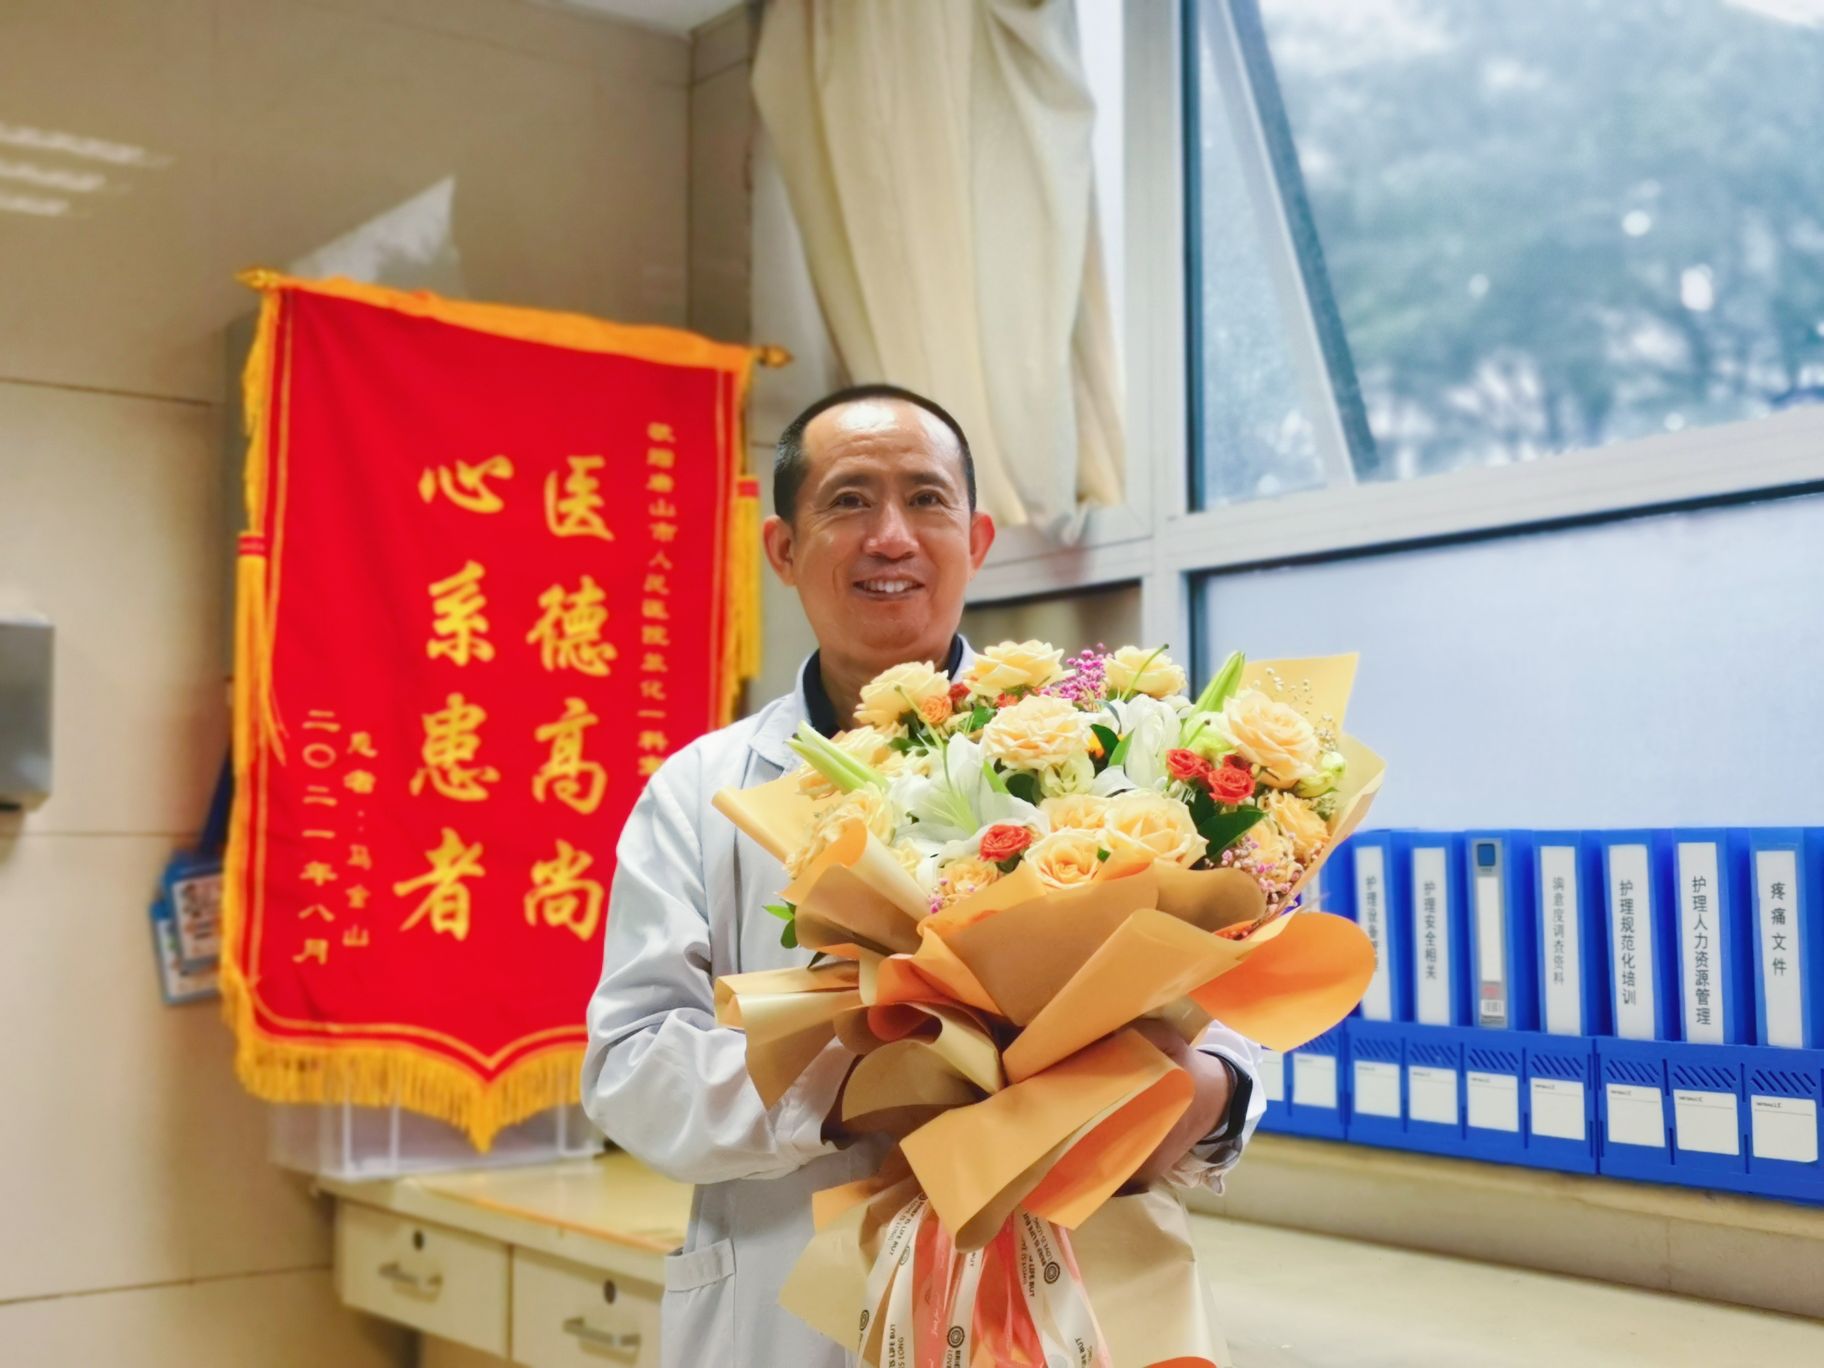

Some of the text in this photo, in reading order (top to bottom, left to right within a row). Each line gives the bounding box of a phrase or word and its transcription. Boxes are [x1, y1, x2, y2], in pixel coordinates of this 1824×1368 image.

[393, 455, 514, 941] 心系患者
[524, 455, 618, 941] 医德高尚
[1619, 880, 1637, 1006] 护理规范化培训
[1692, 876, 1711, 1026] 护理人力资源管理
[1770, 882, 1787, 976] 疼痛文件
[897, 1337, 905, 1360] LONG
